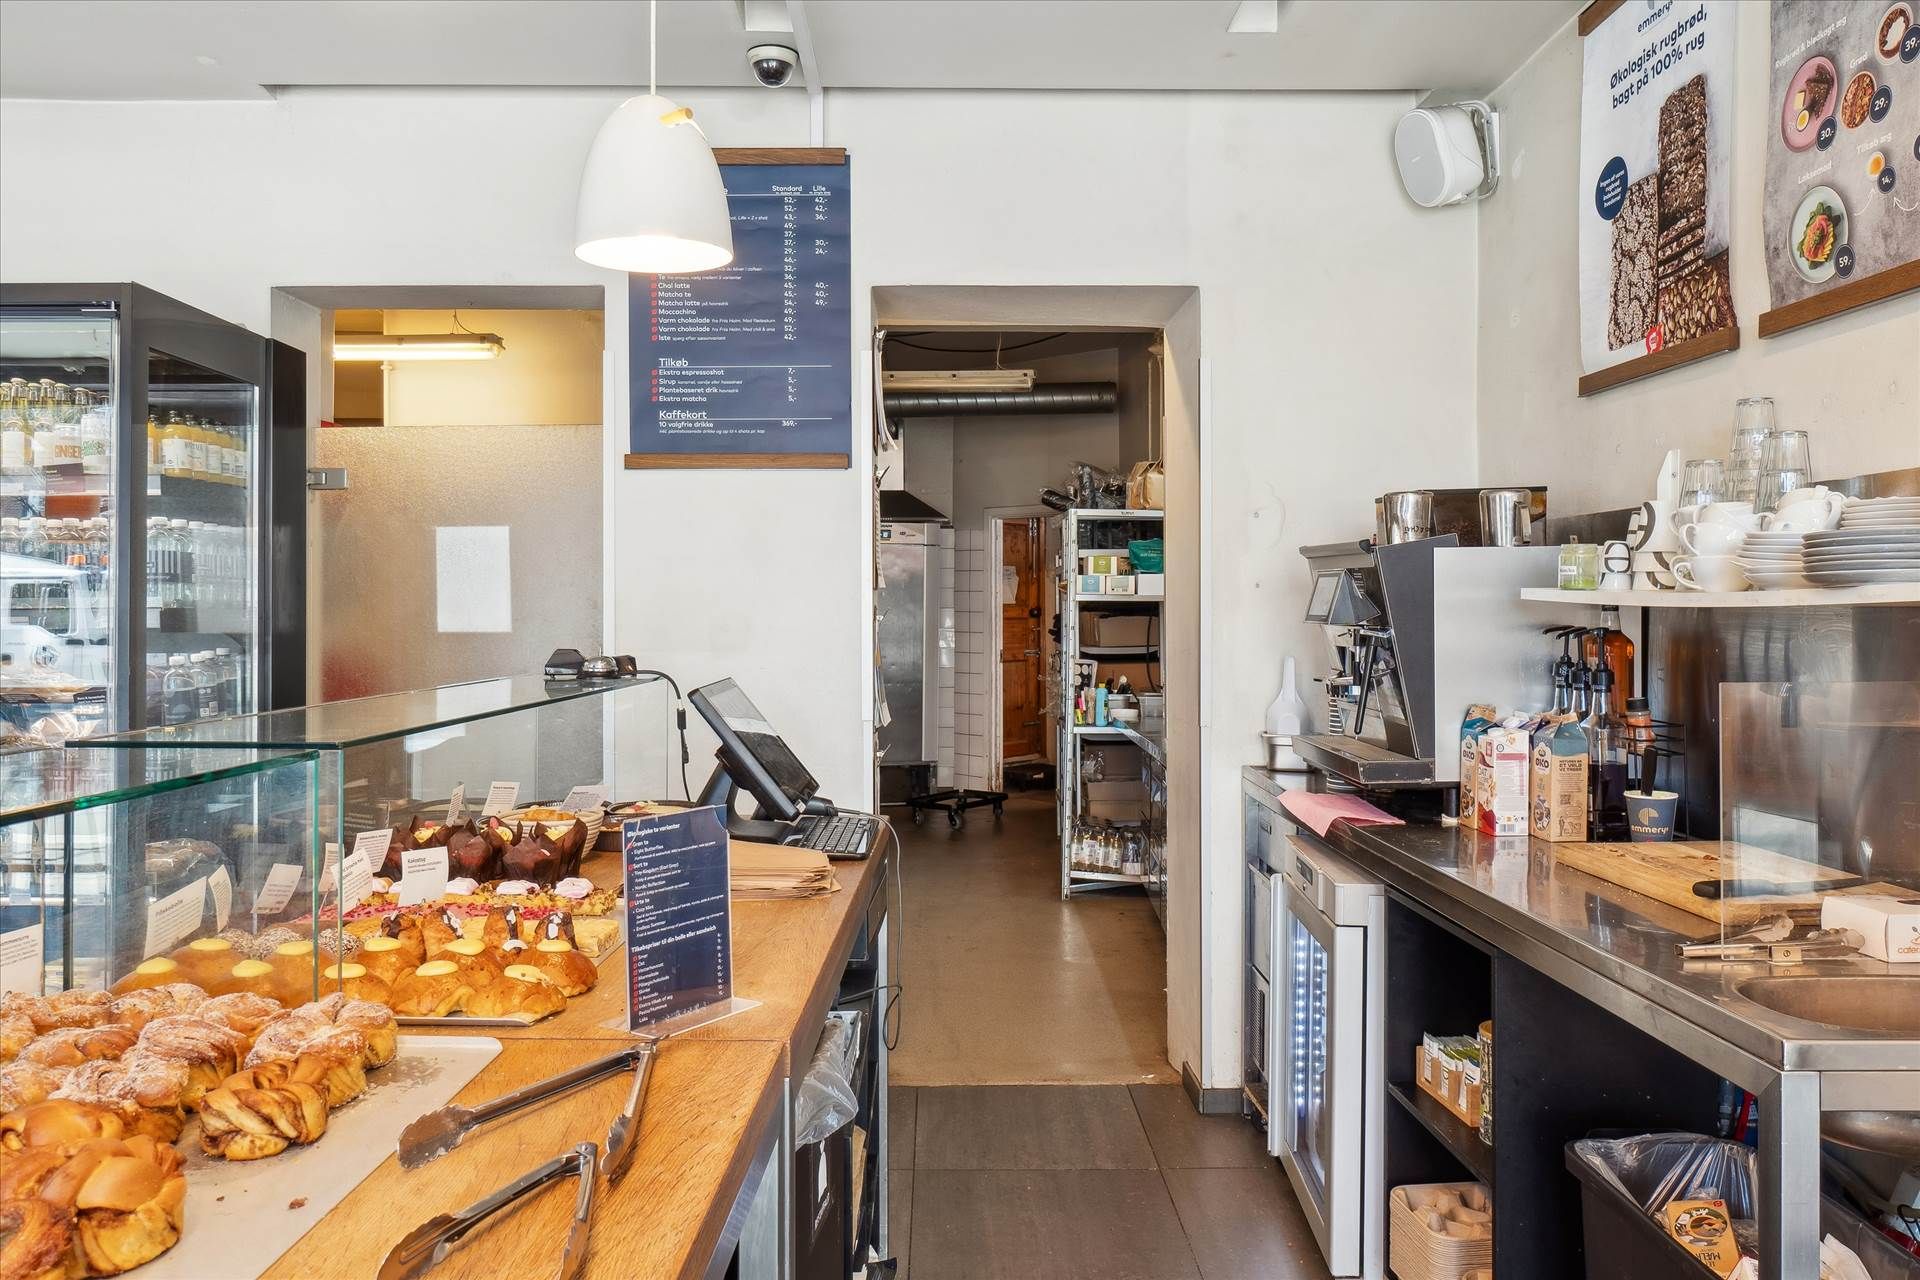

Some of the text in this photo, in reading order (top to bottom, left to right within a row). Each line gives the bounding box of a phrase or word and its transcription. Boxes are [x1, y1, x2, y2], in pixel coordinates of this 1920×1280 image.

[1637, 1, 1673, 33] emmerys
[1610, 4, 1707, 89] Økologisk rugbrød,
[1612, 31, 1705, 110] bagt på 100% rug
[658, 358, 689, 367] Tilkøb
[681, 369, 724, 377] espressoshot
[659, 386, 705, 394] Plantebaseret
[705, 386, 719, 394] drik
[659, 410, 708, 419] Kaffekort
